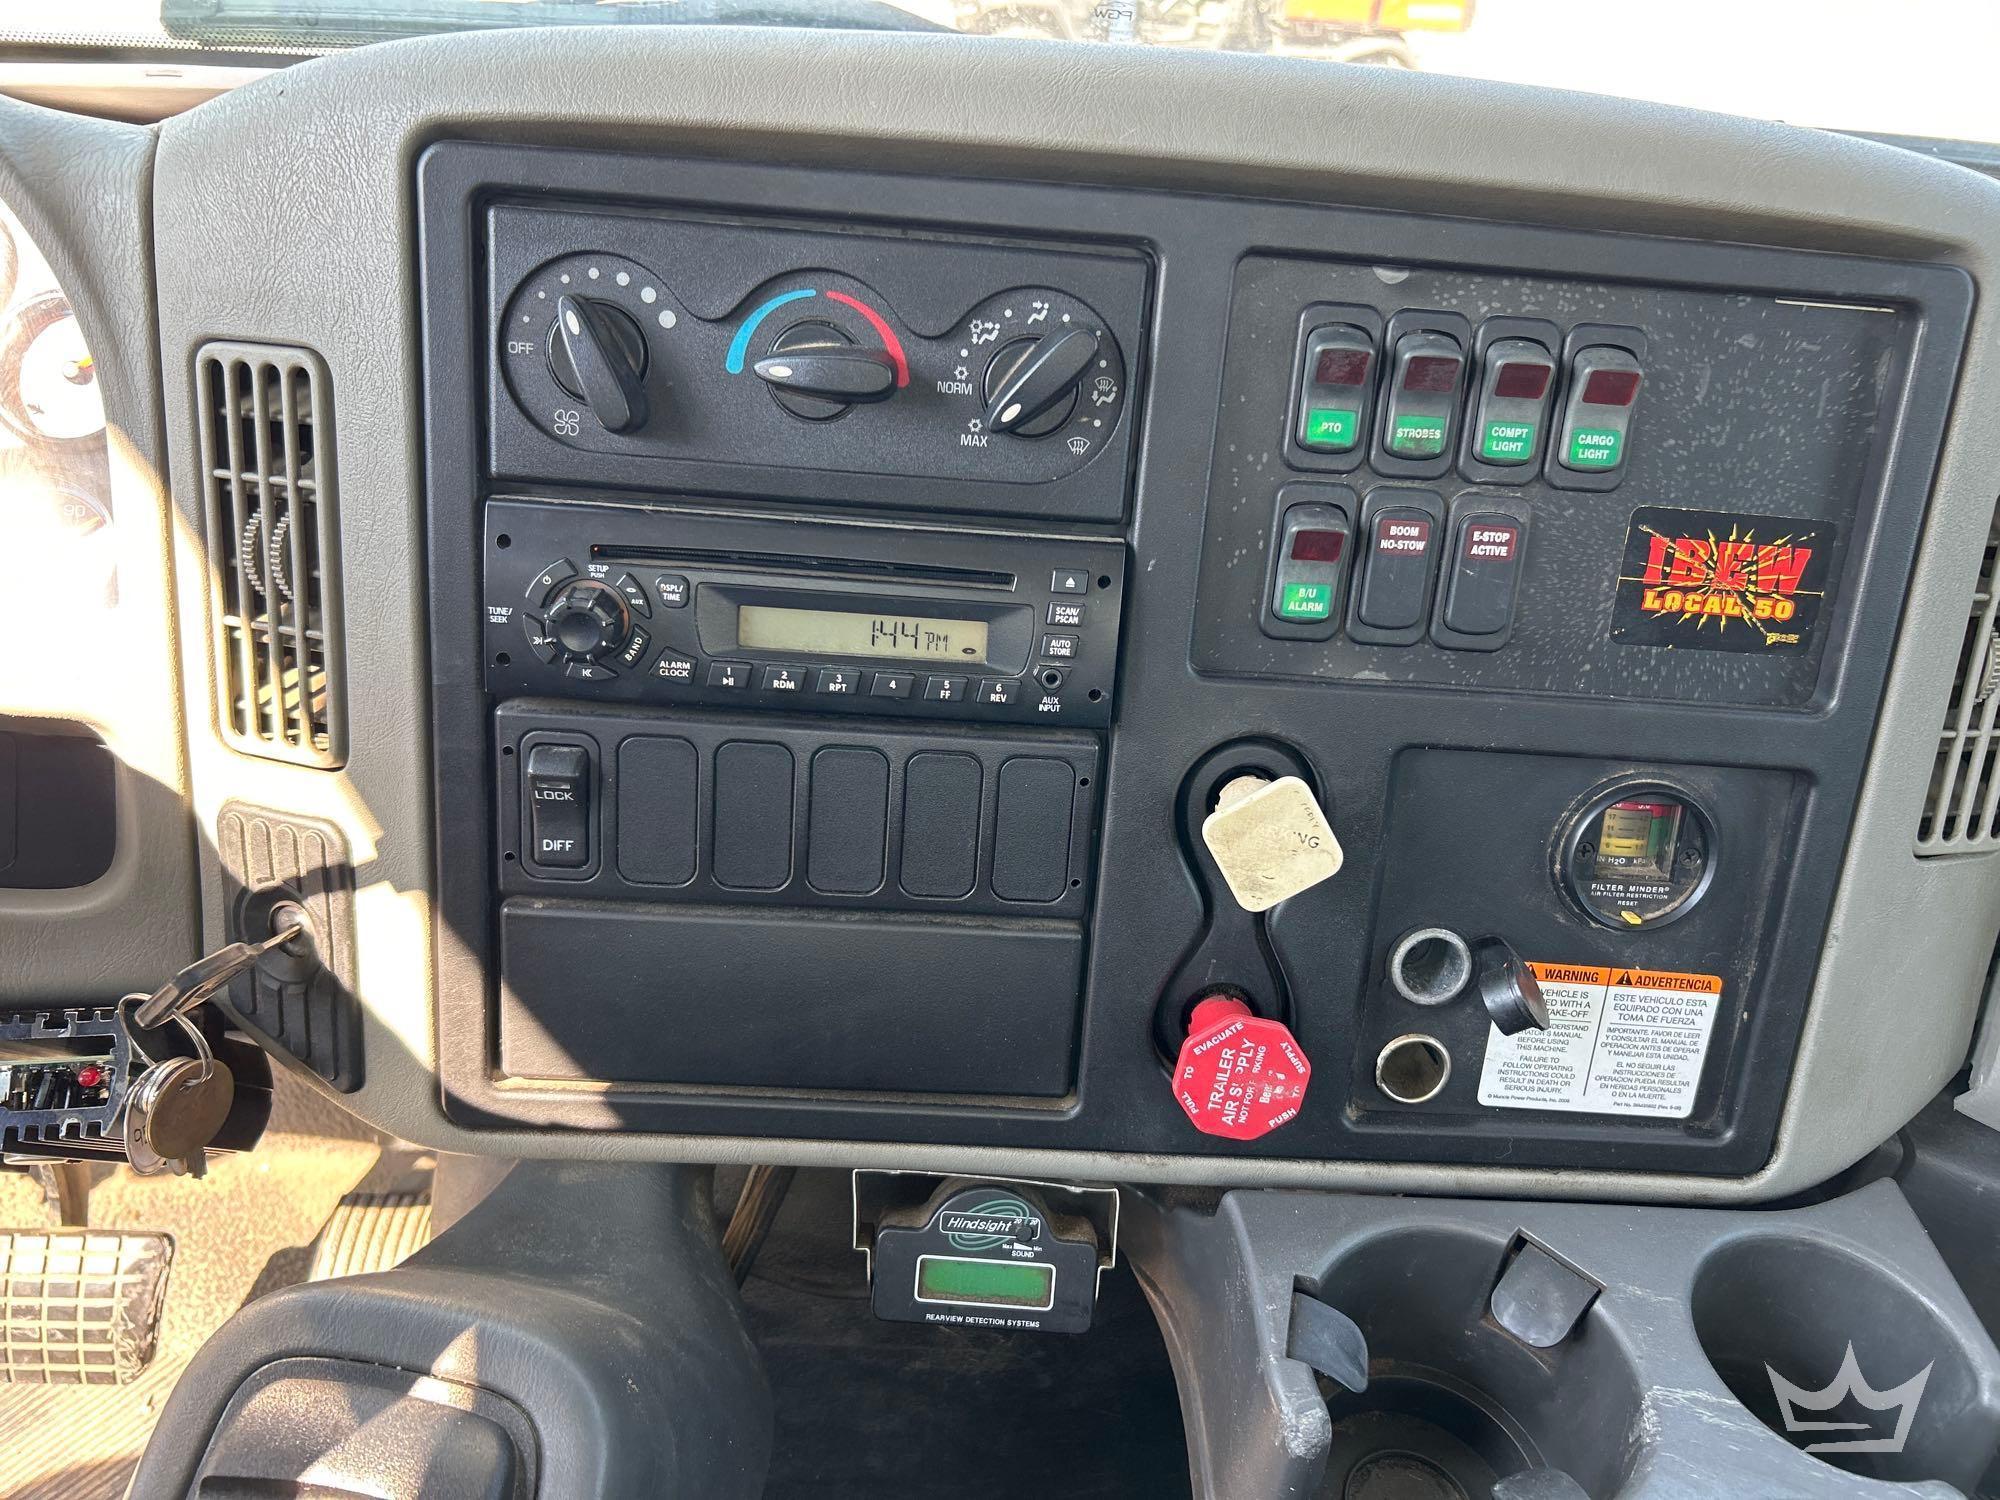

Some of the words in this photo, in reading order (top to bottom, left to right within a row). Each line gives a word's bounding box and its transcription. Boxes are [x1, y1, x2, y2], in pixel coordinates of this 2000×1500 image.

[508, 342, 534, 355] OFF
[937, 381, 973, 396] NORM
[1320, 421, 1343, 433] PTO
[1491, 426, 1529, 439] COMPT
[1396, 428, 1441, 440] STROBES
[960, 433, 989, 448] MAX
[1491, 440, 1524, 452] LIGHT
[1578, 434, 1615, 447] CARGO
[1578, 447, 1609, 460] LIGHT
[1390, 525, 1420, 537] BOOM
[1472, 531, 1511, 543] E-STOP
[1380, 540, 1426, 551] NO-STOW
[1470, 546, 1508, 557] ACTIVE
[588, 564, 609, 573] SETUP
[1642, 536, 1813, 595] IBEW
[662, 592, 681, 601] TIME
[1299, 588, 1318, 599] B/U
[1288, 601, 1324, 612] ALARM
[1641, 588, 1743, 618] LOCAL
[1754, 598, 1796, 621] 50
[488, 606, 513, 617] TUNE/
[1055, 606, 1080, 617] SCAN/
[489, 615, 508, 624] SEEK
[1055, 615, 1079, 624] PSCAN
[872, 620, 919, 650] 1:44
[925, 632, 949, 652] PM
[625, 637, 643, 661] BAND
[1050, 640, 1071, 649] AUTO
[1049, 647, 1071, 656] STORE
[660, 661, 691, 669] ALARM
[660, 669, 689, 677] CLOCK
[726, 667, 731, 676] 1
[781, 671, 787, 680] 2
[836, 674, 842, 683] 3
[773, 680, 795, 690] RDM
[829, 682, 847, 692] RPT
[889, 680, 896, 690] 4
[944, 680, 950, 690] 5
[996, 683, 1002, 692] 6
[940, 690, 951, 700] FF
[990, 693, 1007, 703] REV
[1041, 696, 1060, 705] AUX
[1038, 703, 1061, 713] INPUT
[535, 790, 574, 801] LOCK
[542, 839, 574, 851] DIFF
[1545, 968, 1600, 983] WARNING
[1634, 975, 1712, 991] ADVERTENCIA
[1580, 991, 1589, 999] IS
[1613, 994, 1636, 1002] ESTE
[1638, 995, 1684, 1005] VEHICULO
[1686, 998, 1708, 1007] ESTA
[1560, 1000, 1583, 1008] WITH
[1584, 1001, 1591, 1009] A
[1613, 1003, 1660, 1014] EQUIPADO
[1662, 1006, 1683, 1015] CON
[1684, 1008, 1703, 1017] UNA
[1618, 1013, 1644, 1022] TOMA
[1646, 1015, 1659, 1023] DE
[1660, 1016, 1696, 1025] FUERZA
[1193, 1021, 1244, 1056] EVACUATE
[1553, 1031, 1583, 1039] MANUAL
[1611, 1035, 1650, 1043] CONSULTAR
[1517, 1036, 1546, 1044] BEFORE
[1548, 1038, 1570, 1046] USING
[1280, 1042, 1306, 1074] SUPPLY
[1520, 1055, 1548, 1063] FAILURE
[1613, 1050, 1645, 1058] MANEJAR
[1184, 1066, 1195, 1080] TO
[1534, 1064, 1573, 1072] OPERATING
[1613, 1069, 1665, 1078] INSTRUCCIONES
[1207, 1047, 1236, 1111] TRAILER
[1498, 1069, 1549, 1078] INSTRUCTIONS
[1550, 1072, 1576, 1080] COULD
[1504, 1084, 1535, 1092] SERIOUS
[1610, 1083, 1638, 1091] HERIDAS
[1639, 1085, 1682, 1094] PERSONALES
[1657, 1079, 1690, 1087] RESULTAR
[1181, 1091, 1200, 1114] PULL
[1237, 1103, 1249, 1123] NOT
[1244, 1085, 1255, 1105] FOR
[1222, 1101, 1240, 1127] AIR
[1268, 1107, 1298, 1128] PUSH
[947, 1217, 1012, 1232] Hindsight
[1011, 1250, 1035, 1258] SOUND
[926, 1313, 963, 1323] REARVIEW
[966, 1316, 1006, 1326] DETECTION
[1007, 1318, 1040, 1328] SYSTEMS
